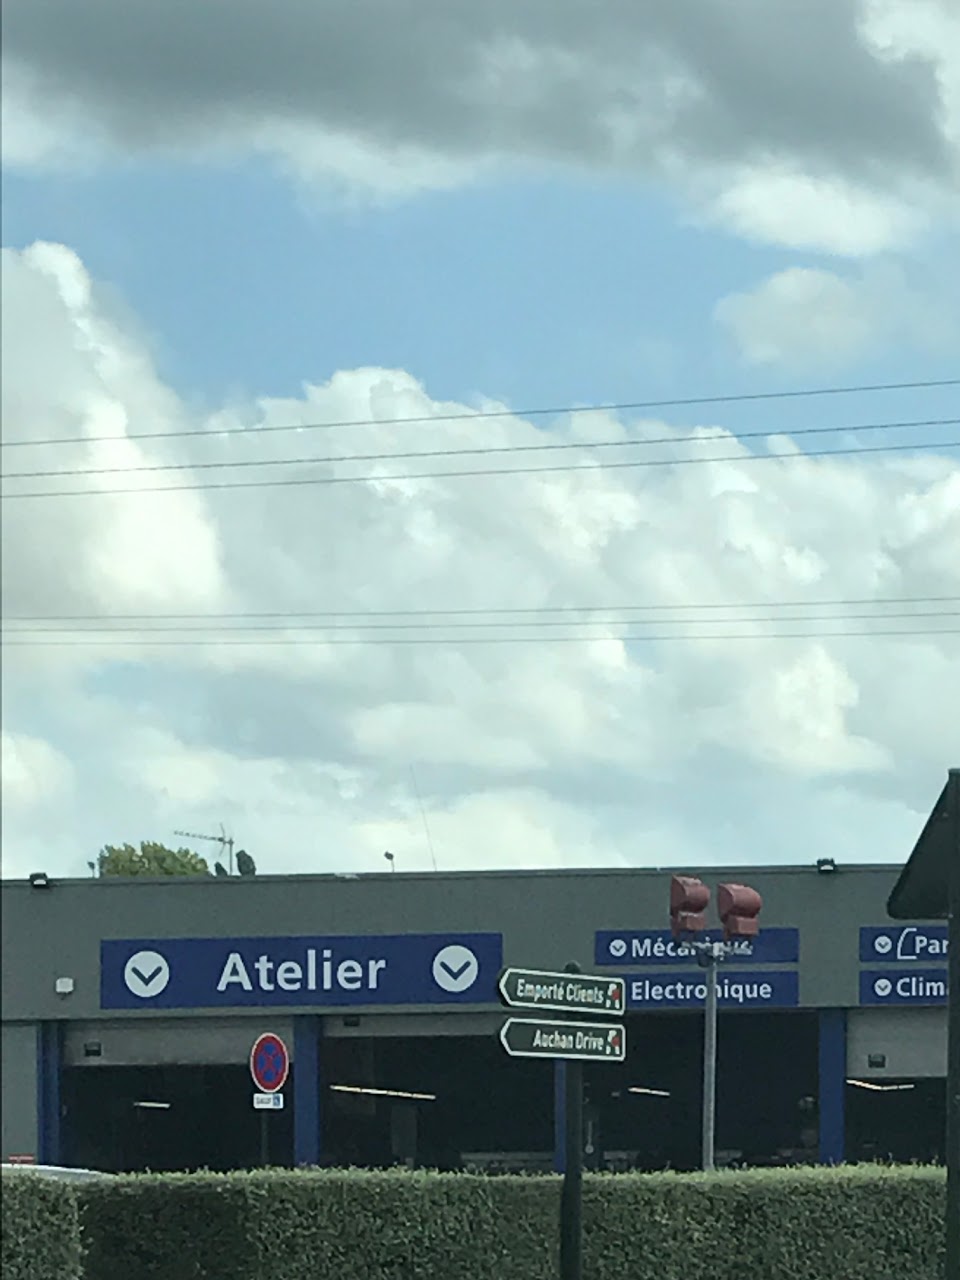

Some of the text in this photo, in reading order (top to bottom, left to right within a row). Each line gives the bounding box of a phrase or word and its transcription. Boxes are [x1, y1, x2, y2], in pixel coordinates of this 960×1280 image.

[216, 949, 387, 991] Atelier
[566, 983, 605, 1004] Clients
[532, 1029, 605, 1051] Auchan Drive
